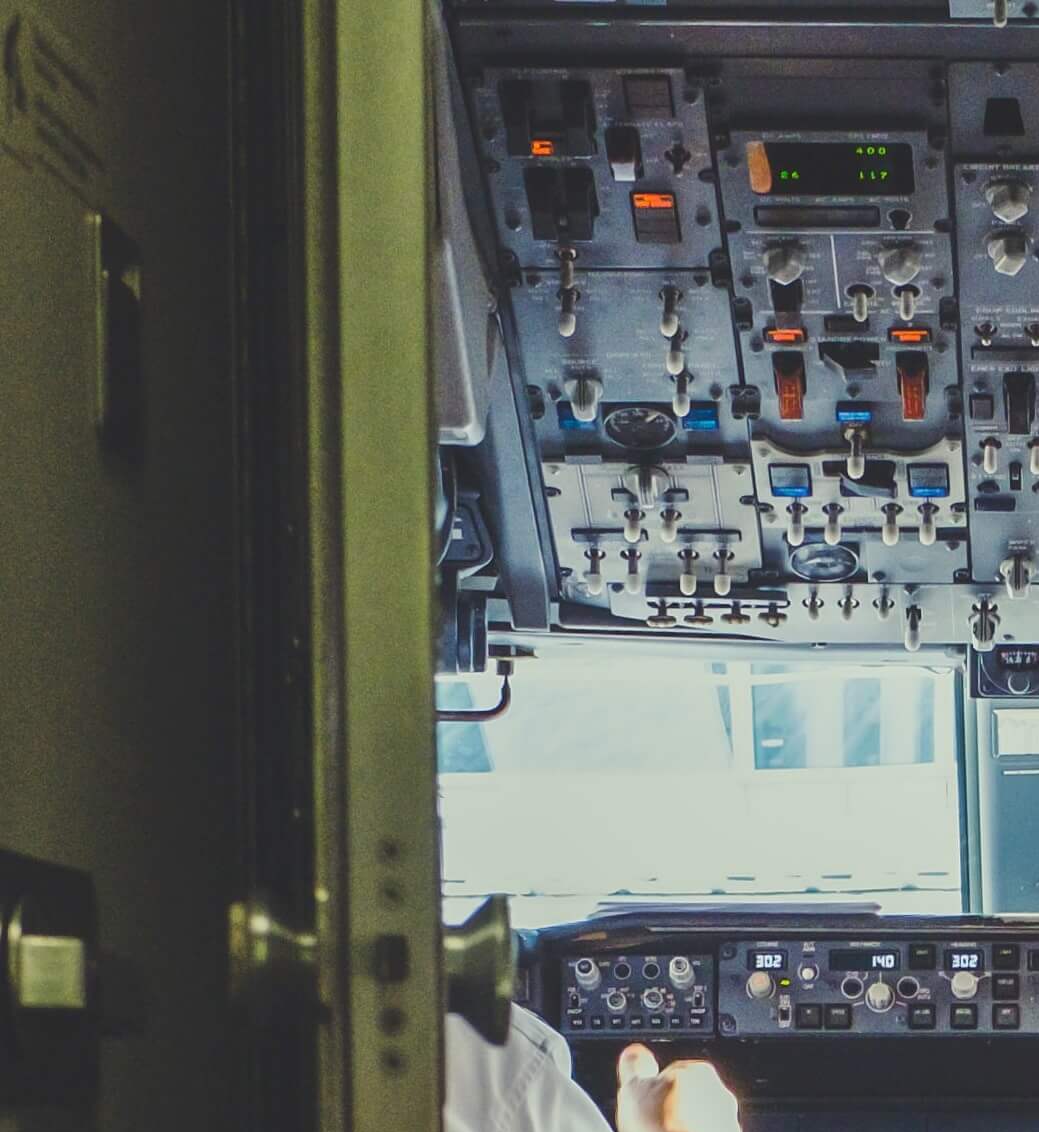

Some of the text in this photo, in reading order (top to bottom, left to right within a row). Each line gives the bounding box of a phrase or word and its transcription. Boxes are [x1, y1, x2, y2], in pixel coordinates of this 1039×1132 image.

[856, 146, 887, 156] 400
[859, 171, 888, 180] 117
[755, 954, 783, 968] 302
[872, 954, 895, 968] 140
[952, 954, 978, 968] 302
